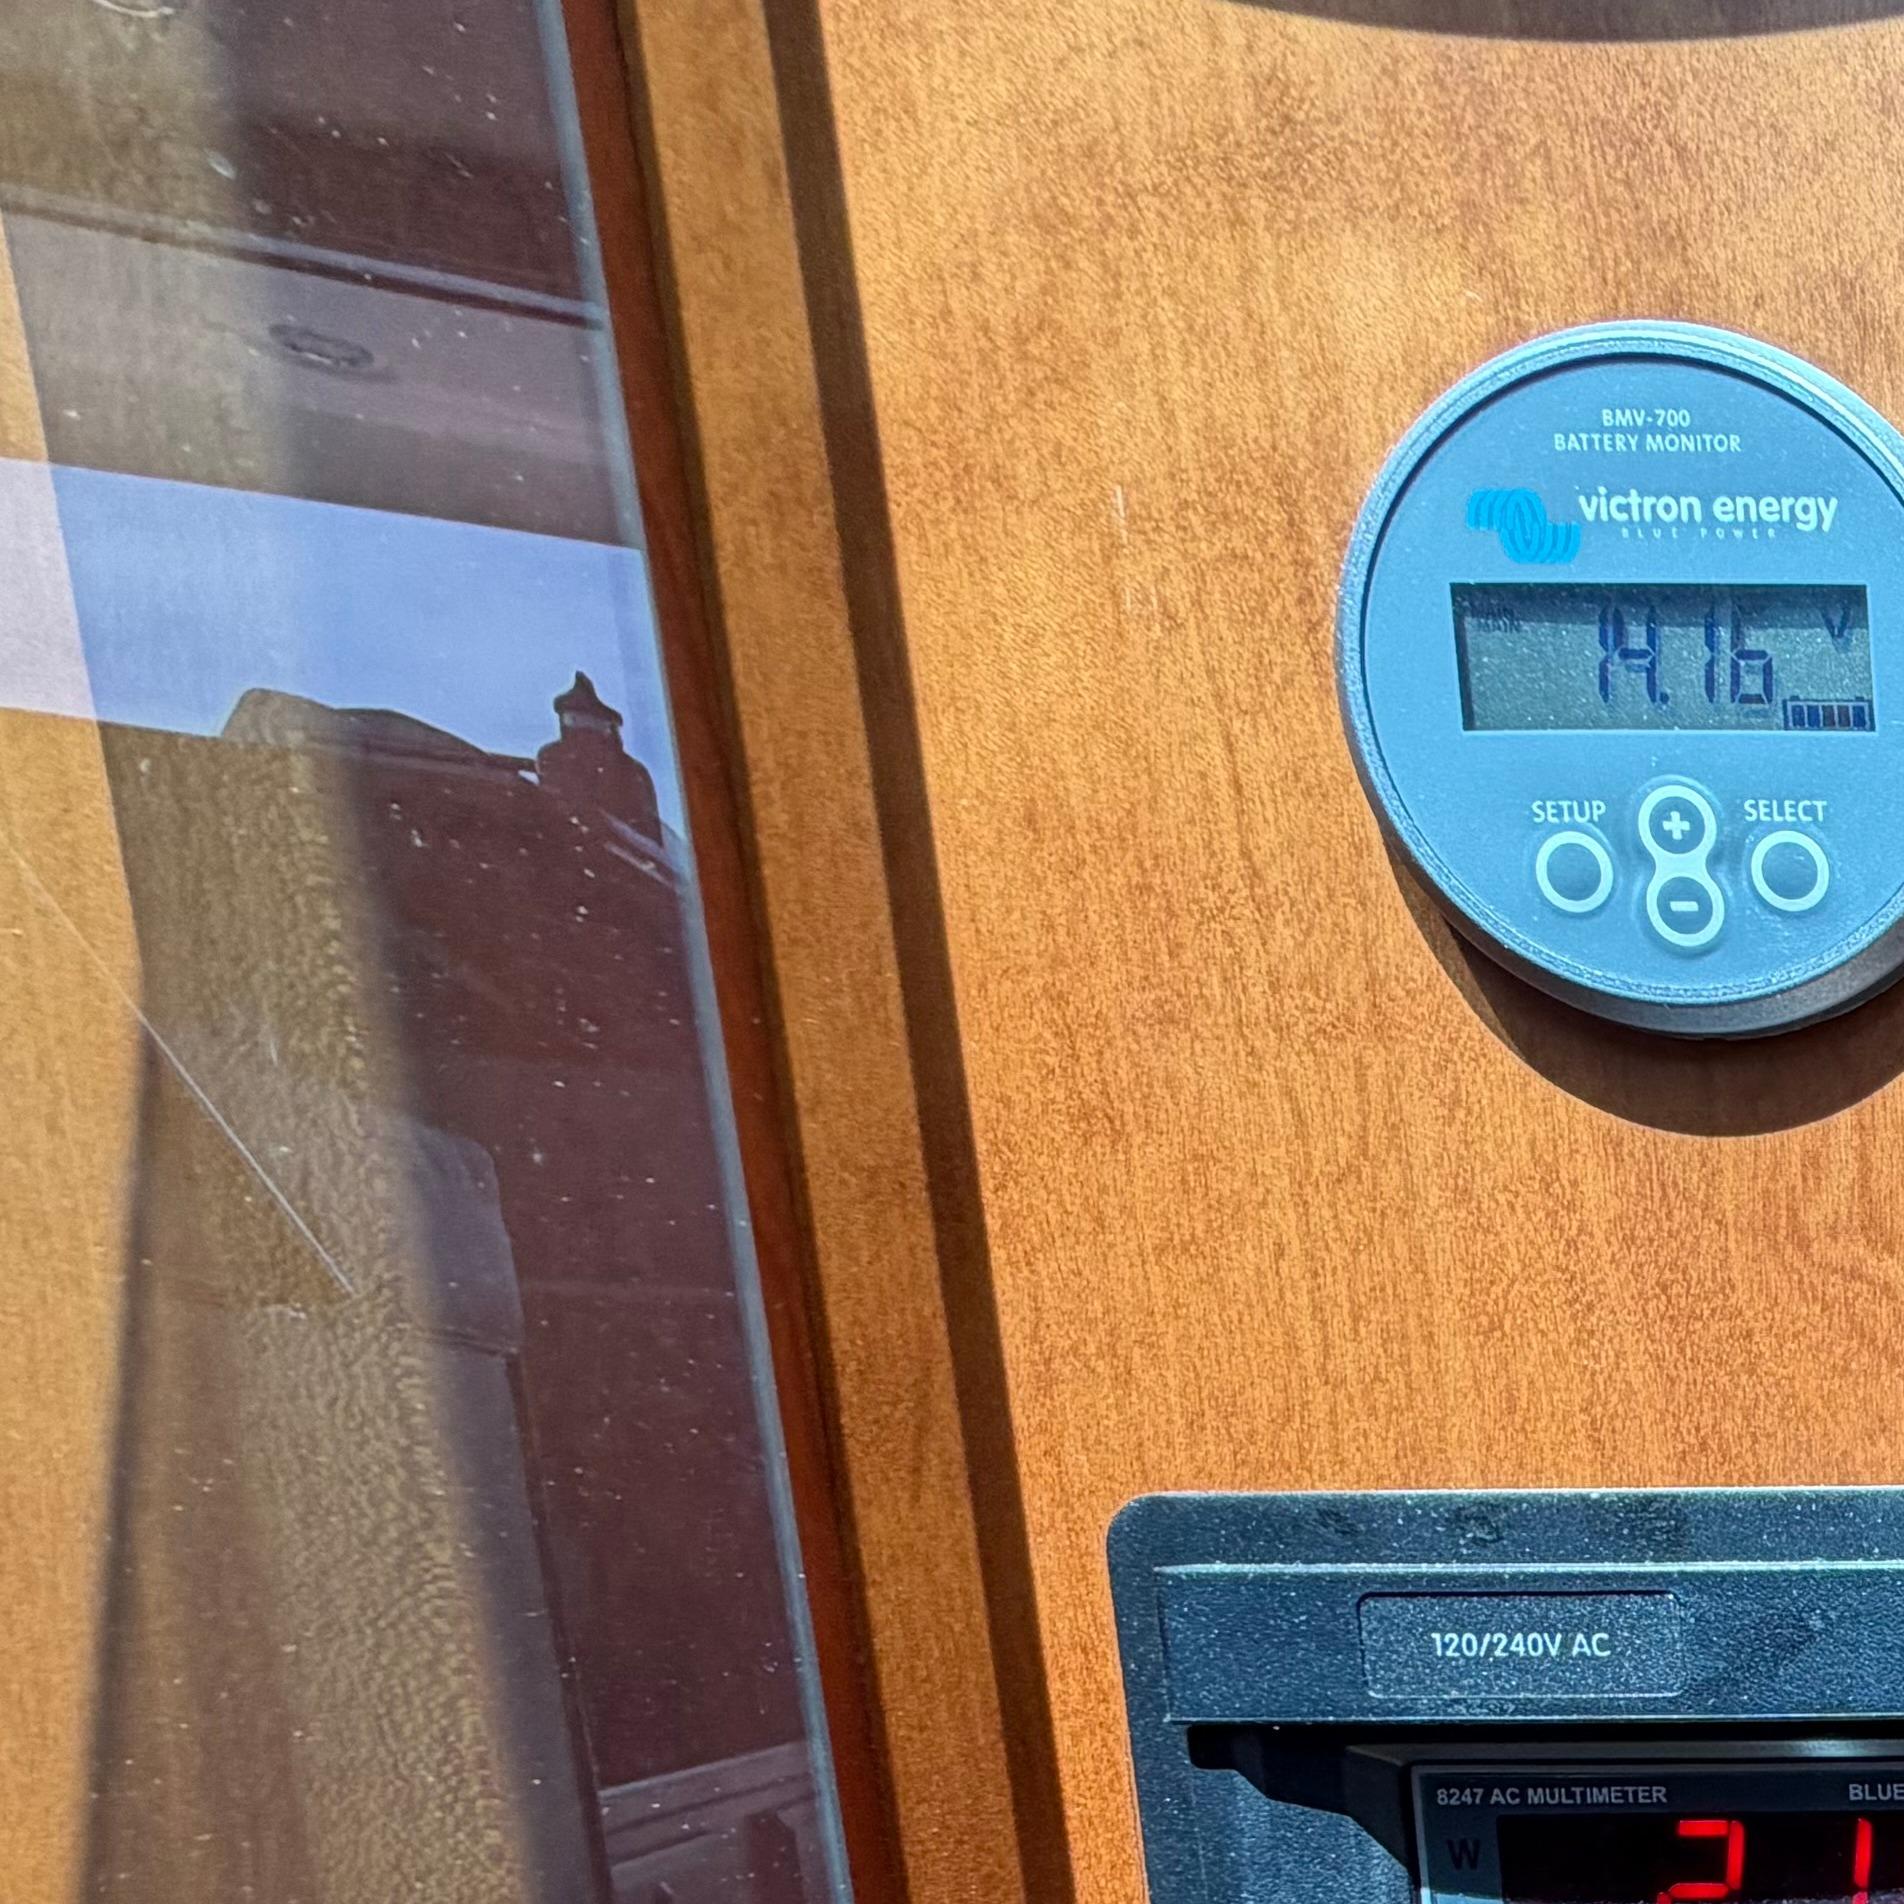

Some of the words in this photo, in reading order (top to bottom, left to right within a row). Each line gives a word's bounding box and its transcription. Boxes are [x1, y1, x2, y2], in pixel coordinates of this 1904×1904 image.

[1602, 408, 1691, 428] BMV-700
[1553, 433, 1642, 453] BATTERY
[1645, 433, 1743, 453] MONITOR
[1578, 486, 1702, 523] victron
[1713, 494, 1839, 532] energy
[1620, 527, 1679, 540] BLUE
[1700, 527, 1777, 540] POWER
[1599, 604, 1773, 705] 14.16
[1531, 800, 1606, 823] SETUP
[1744, 800, 1828, 823] SELECT
[1430, 1632, 1562, 1659] 120/240V
[1572, 1633, 1611, 1658] AC
[1436, 1788, 1483, 1807] 8247
[1489, 1788, 1521, 1806] AC
[1526, 1786, 1668, 1806] MULTIMETER
[1447, 1839, 1481, 1871] W
